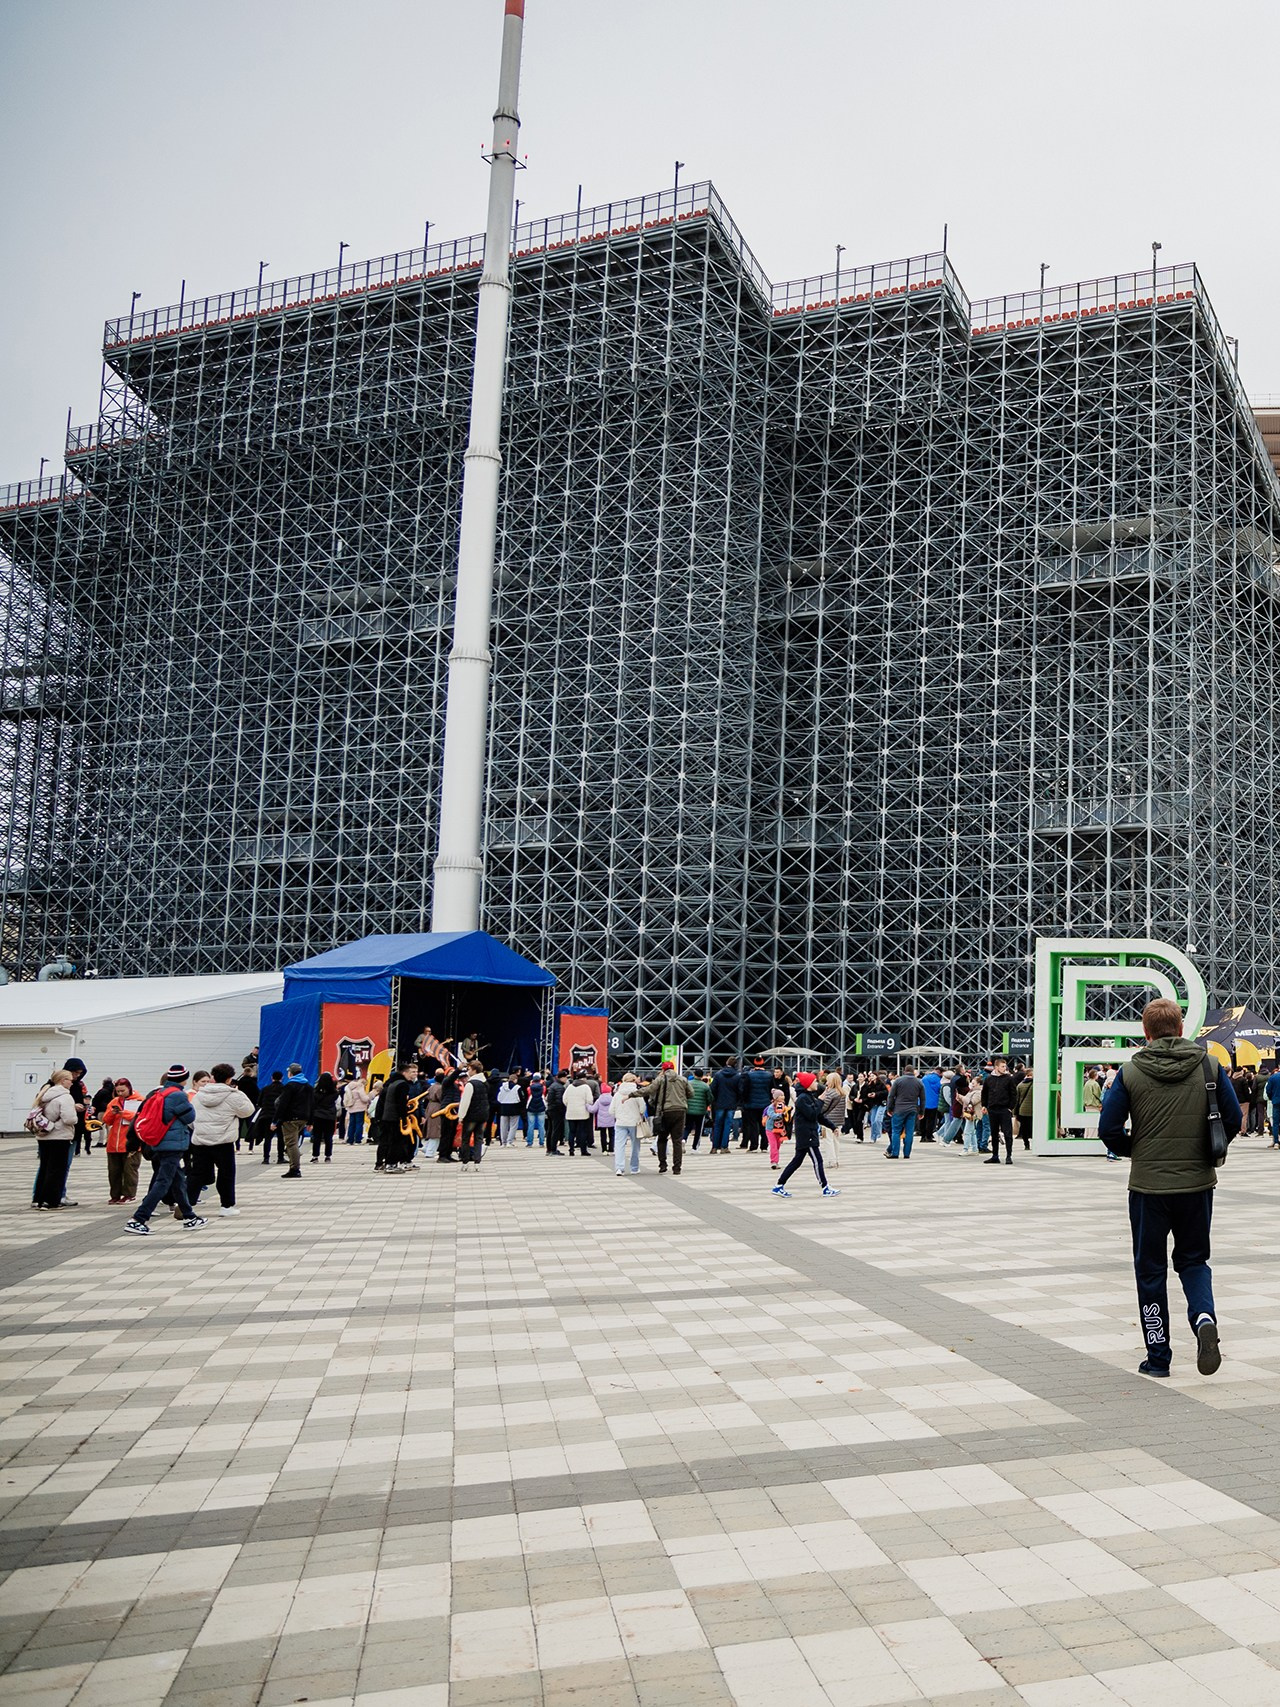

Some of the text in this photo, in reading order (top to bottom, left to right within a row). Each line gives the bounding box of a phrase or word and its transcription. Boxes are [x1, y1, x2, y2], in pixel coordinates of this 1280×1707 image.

[611, 1037, 620, 1049] 8
[886, 1038, 895, 1050] 9
[1143, 1302, 1166, 1345] RUS
